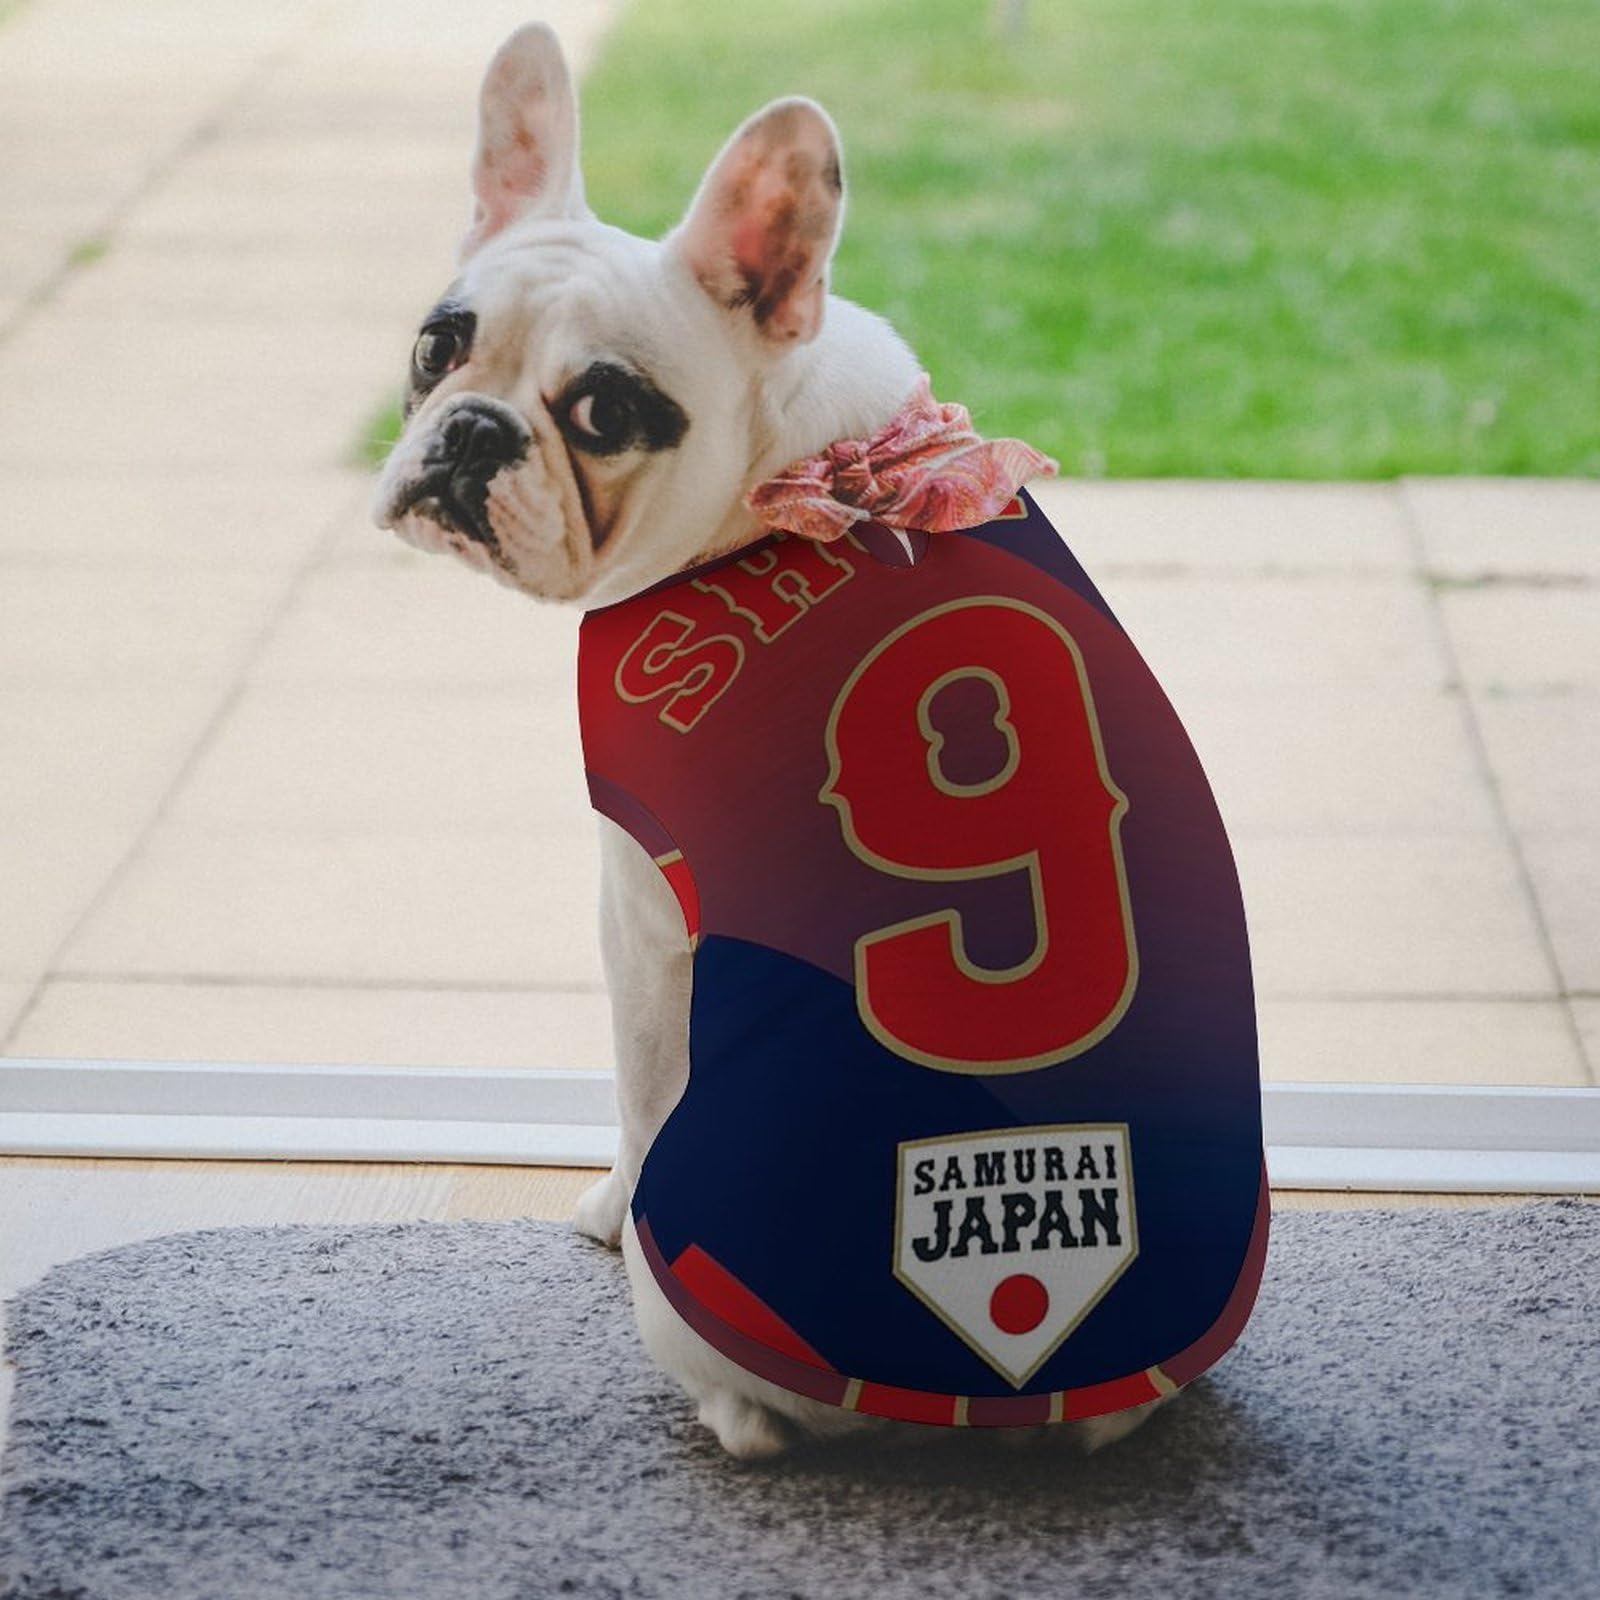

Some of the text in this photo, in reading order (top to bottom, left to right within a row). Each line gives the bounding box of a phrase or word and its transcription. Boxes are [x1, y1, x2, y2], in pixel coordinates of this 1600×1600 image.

[818, 595, 1139, 1075] 9
[913, 1145, 1118, 1196] SAMURAI
[912, 1188, 1122, 1262] JAPAN
